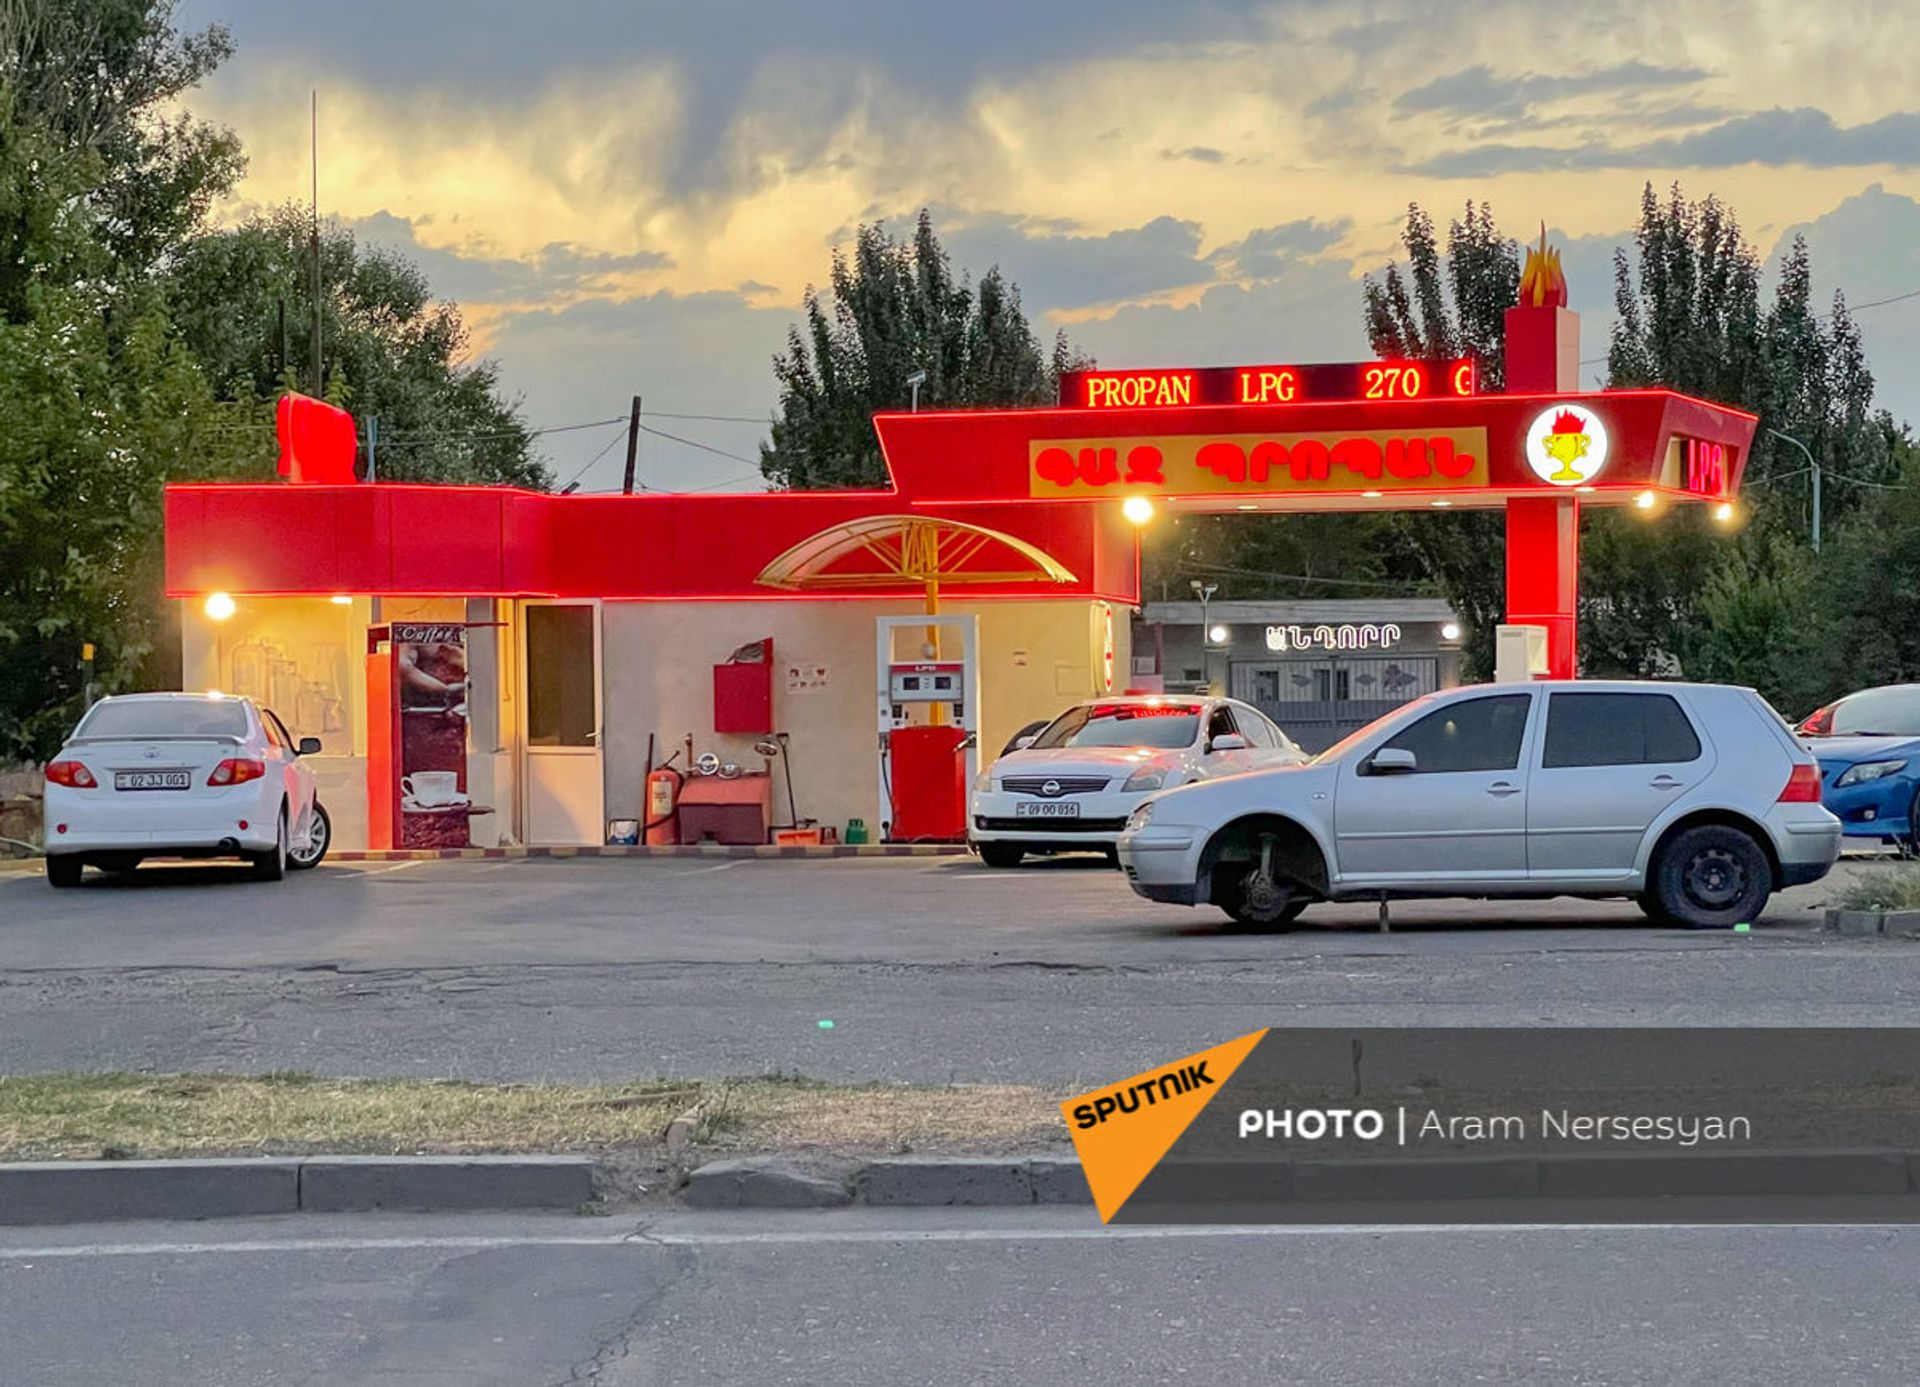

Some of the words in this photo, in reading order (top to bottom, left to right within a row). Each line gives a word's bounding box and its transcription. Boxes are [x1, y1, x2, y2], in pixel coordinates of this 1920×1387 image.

[1087, 376, 1191, 407] PROPAN
[1241, 372, 1294, 402] LPG
[1365, 368, 1420, 398] 270
[1195, 437, 1475, 483] ՊՐՈՊԱՆ
[131, 775, 144, 786] 02
[166, 774, 185, 785] 001
